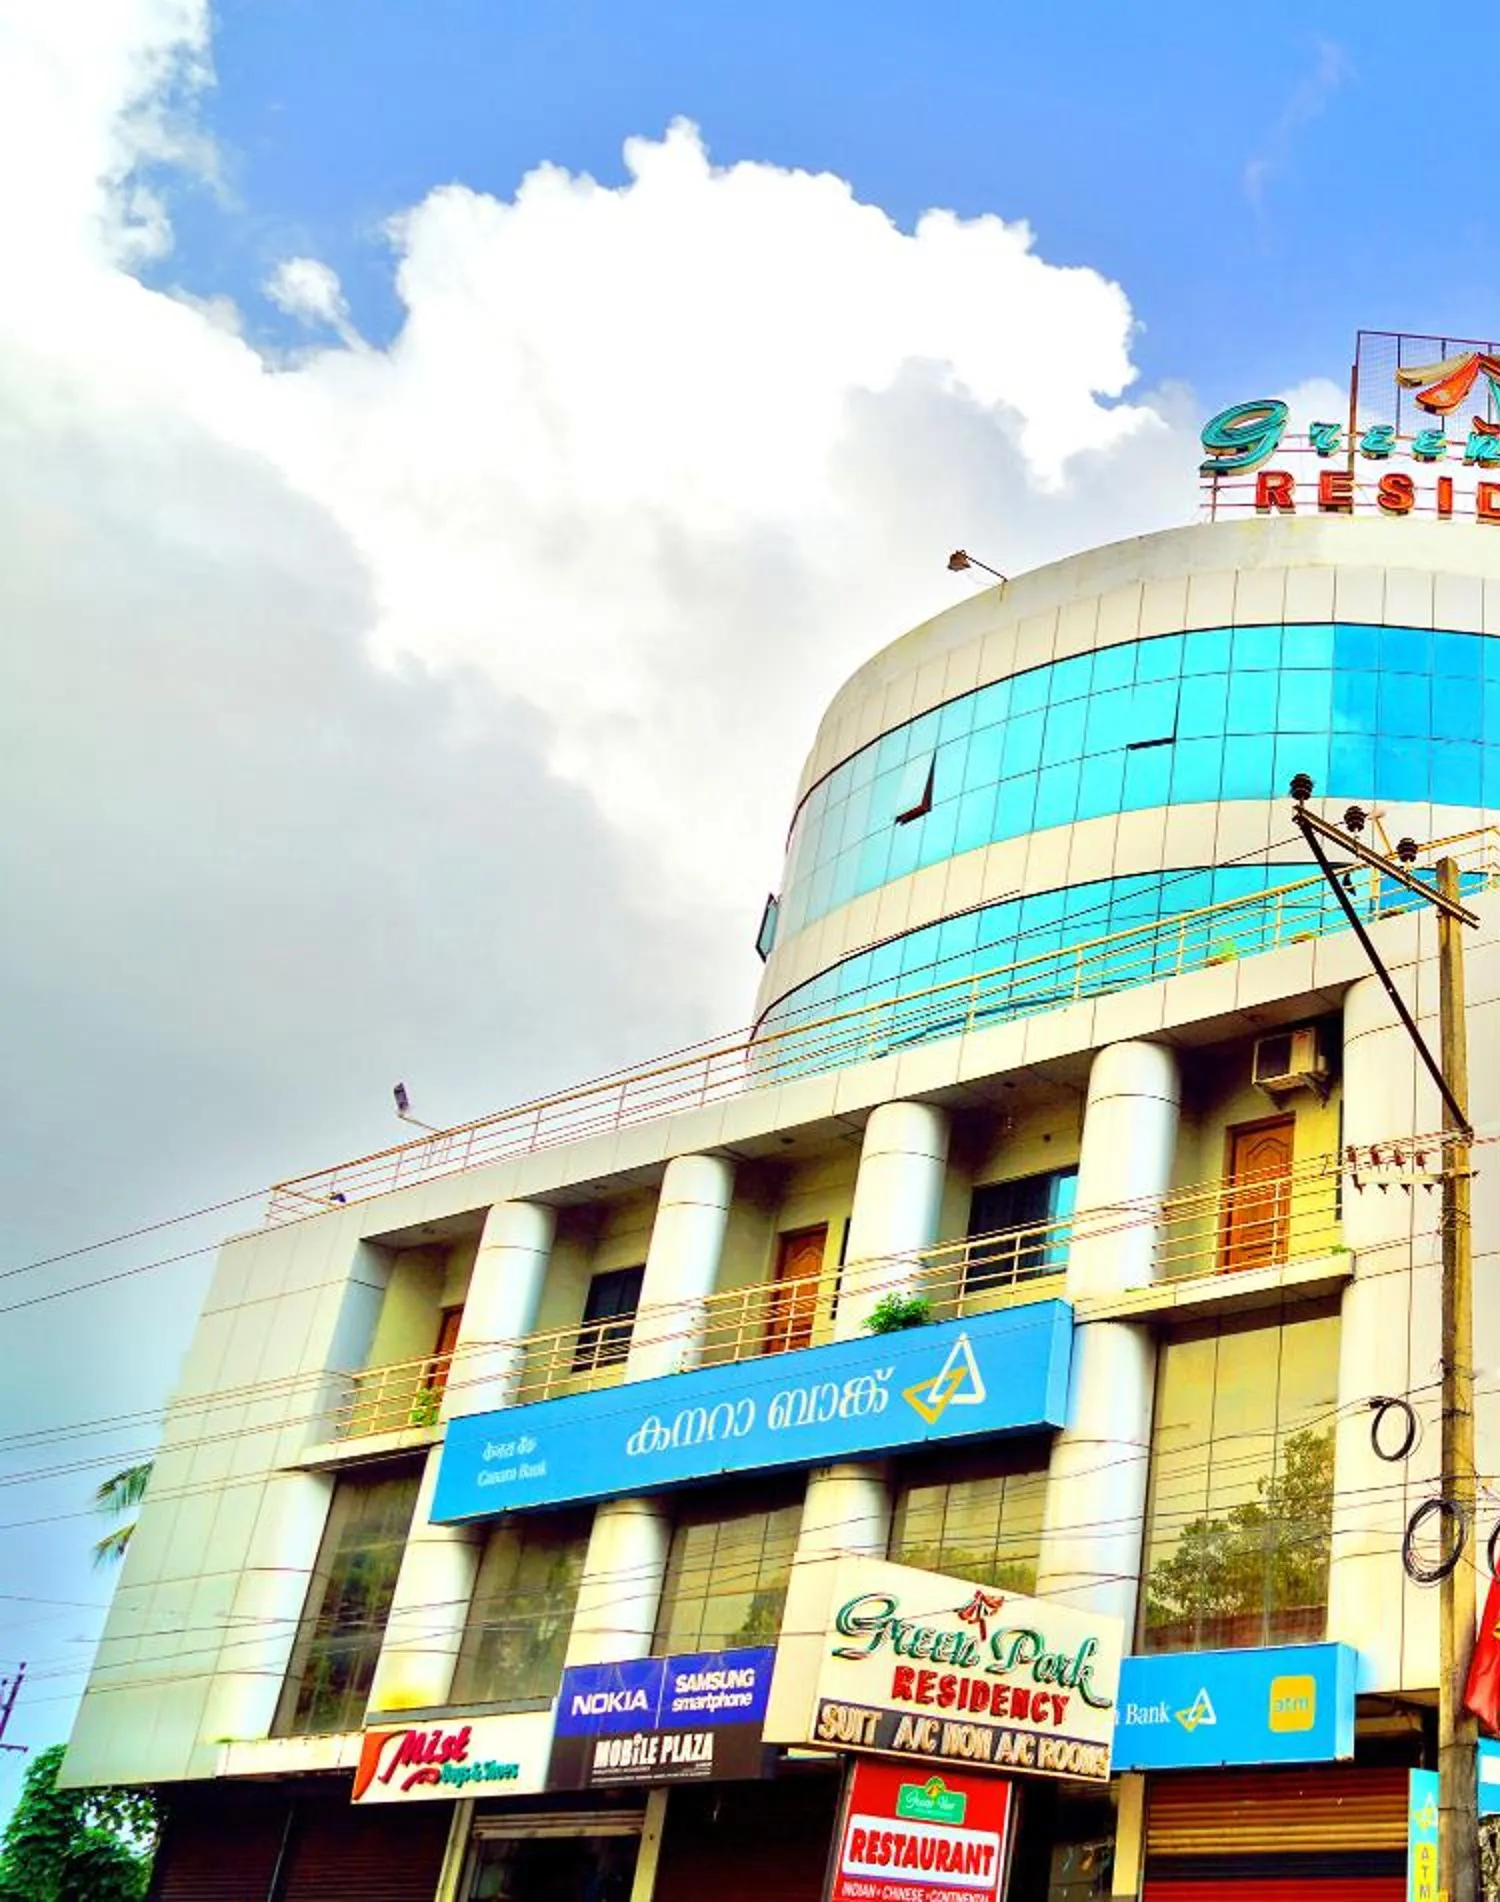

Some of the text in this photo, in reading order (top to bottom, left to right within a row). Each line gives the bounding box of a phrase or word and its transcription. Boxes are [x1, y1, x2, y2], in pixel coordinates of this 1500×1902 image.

[626, 1397, 756, 1456] കനറാ
[832, 1592, 1113, 1709] Green Park
[675, 1668, 756, 1693] SAMSUNG
[891, 1665, 1071, 1726] RESIDENCY
[571, 1689, 649, 1716] NOKIA
[671, 1692, 753, 1712] smartphone
[1125, 1701, 1171, 1725] Bank
[378, 1725, 473, 1784] Mist
[660, 1732, 715, 1764] PLAZA
[819, 1704, 881, 1746] SUIT
[941, 1724, 993, 1761] NON
[994, 1731, 1037, 1769] A/C
[849, 1827, 995, 1877] RESTAURANT
[842, 1880, 877, 1899] INDIAN
[883, 1884, 925, 1902] CHINESE
